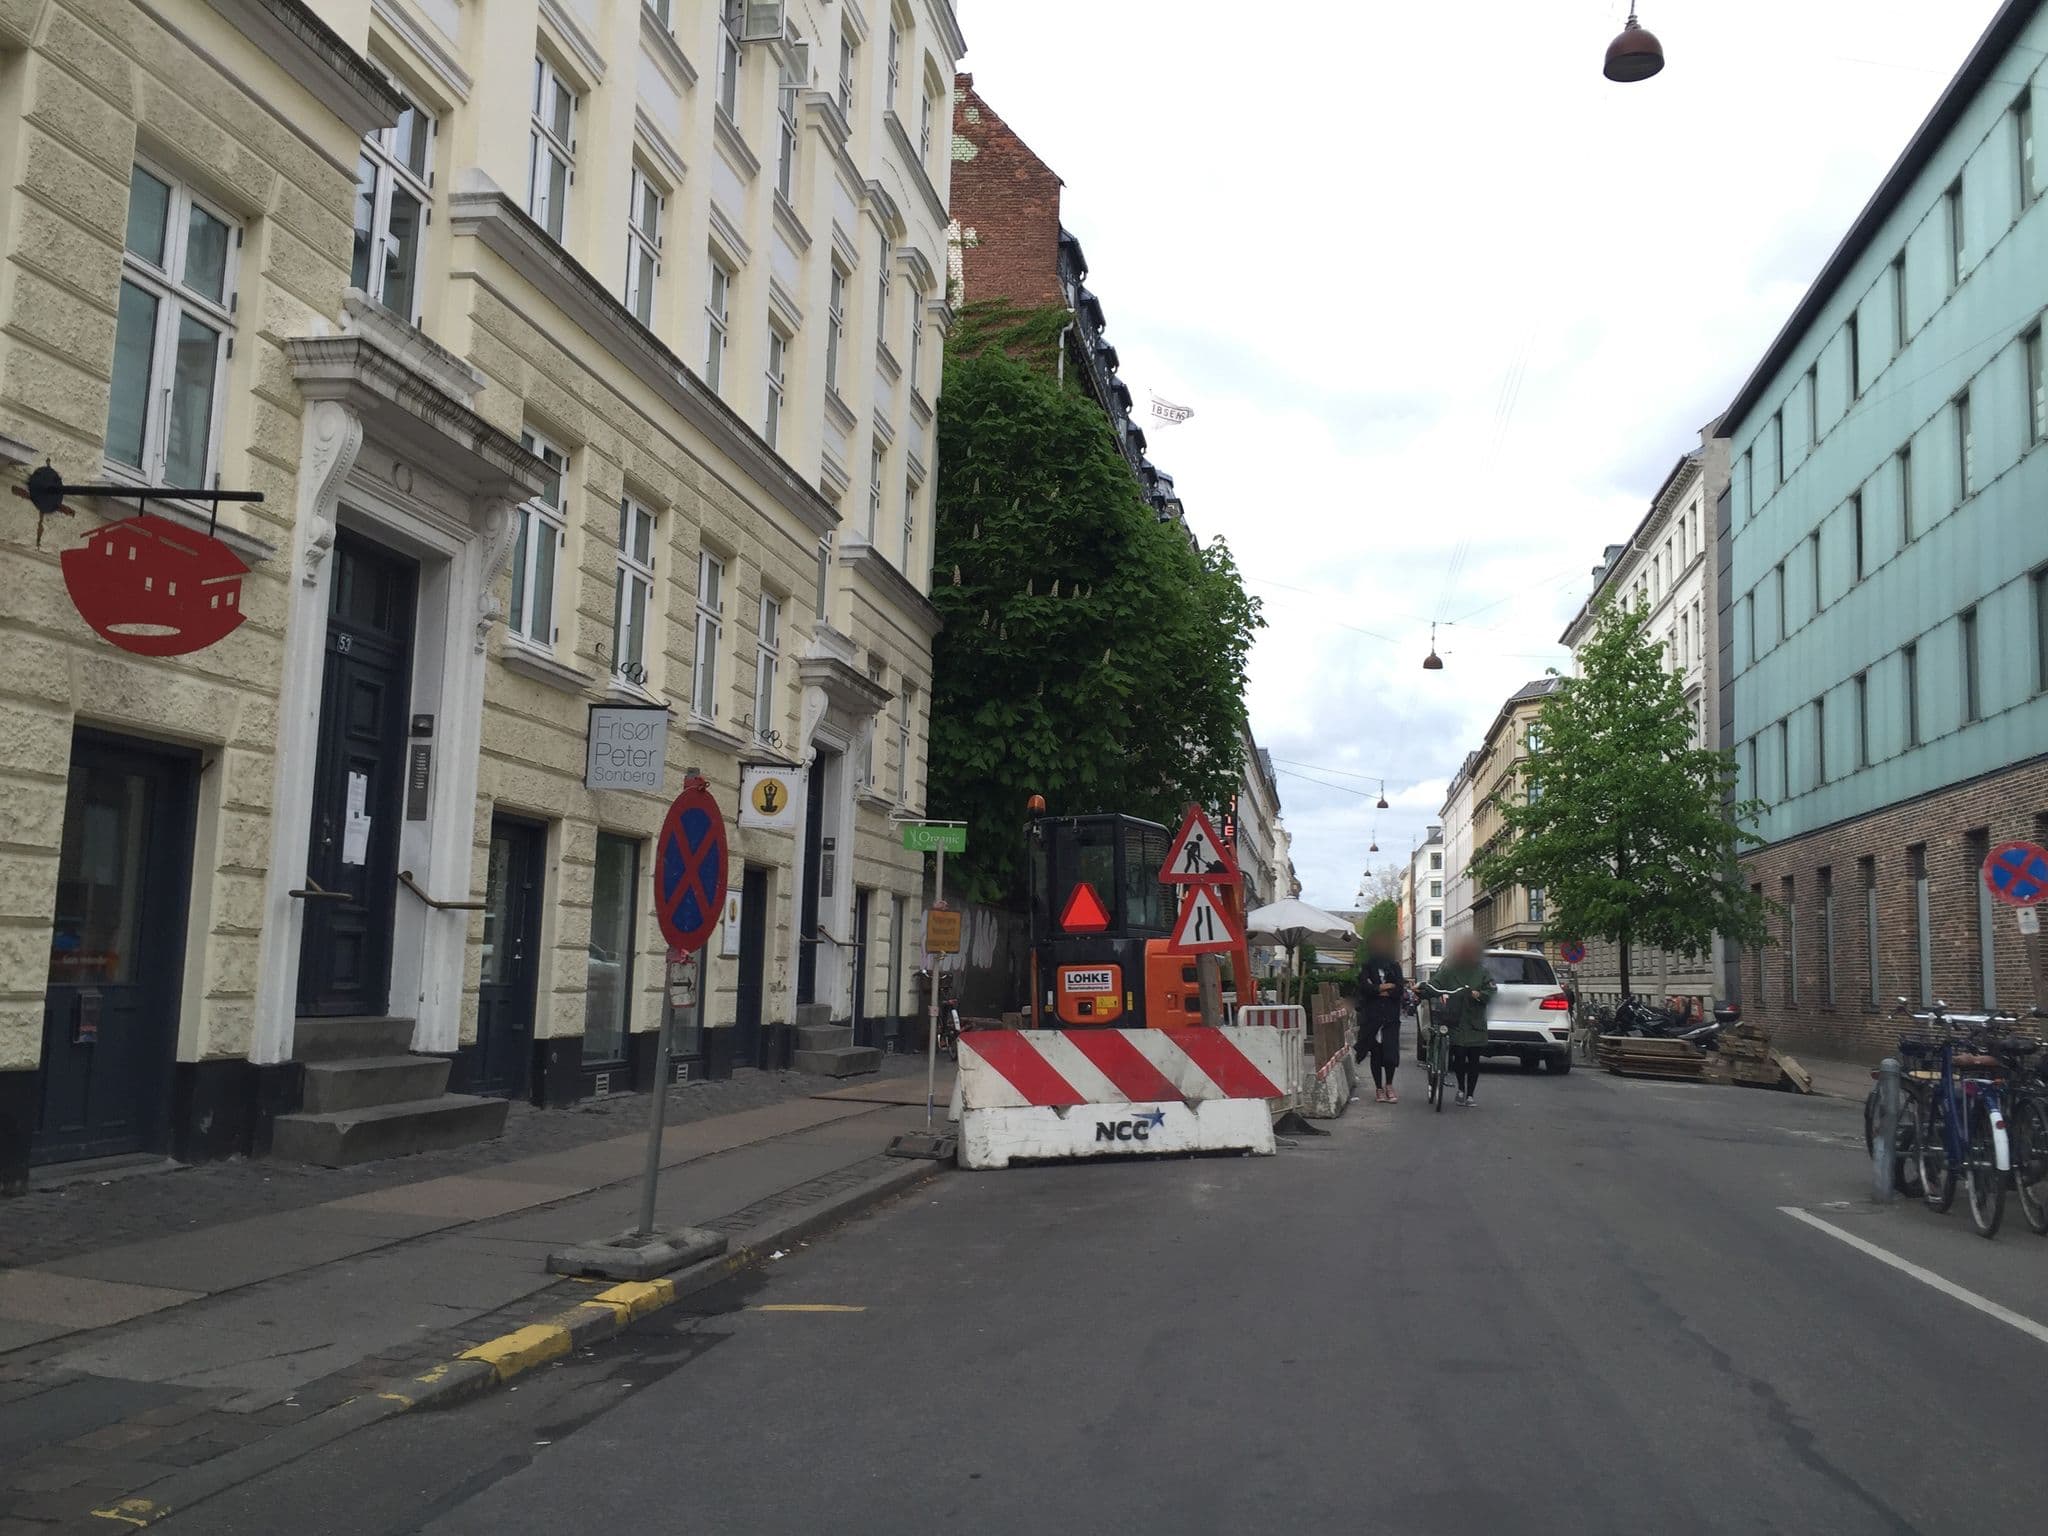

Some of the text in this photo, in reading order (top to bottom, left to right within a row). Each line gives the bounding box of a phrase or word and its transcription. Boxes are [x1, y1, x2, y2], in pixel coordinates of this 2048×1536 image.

[1152, 404, 1185, 421] IBSENS
[340, 636, 351, 651] 53
[597, 715, 660, 740] Frisør
[595, 742, 657, 767] Peter
[594, 766, 656, 785] Sonberg
[1067, 973, 1109, 983] LOHKE
[1096, 1120, 1150, 1141] NCC
